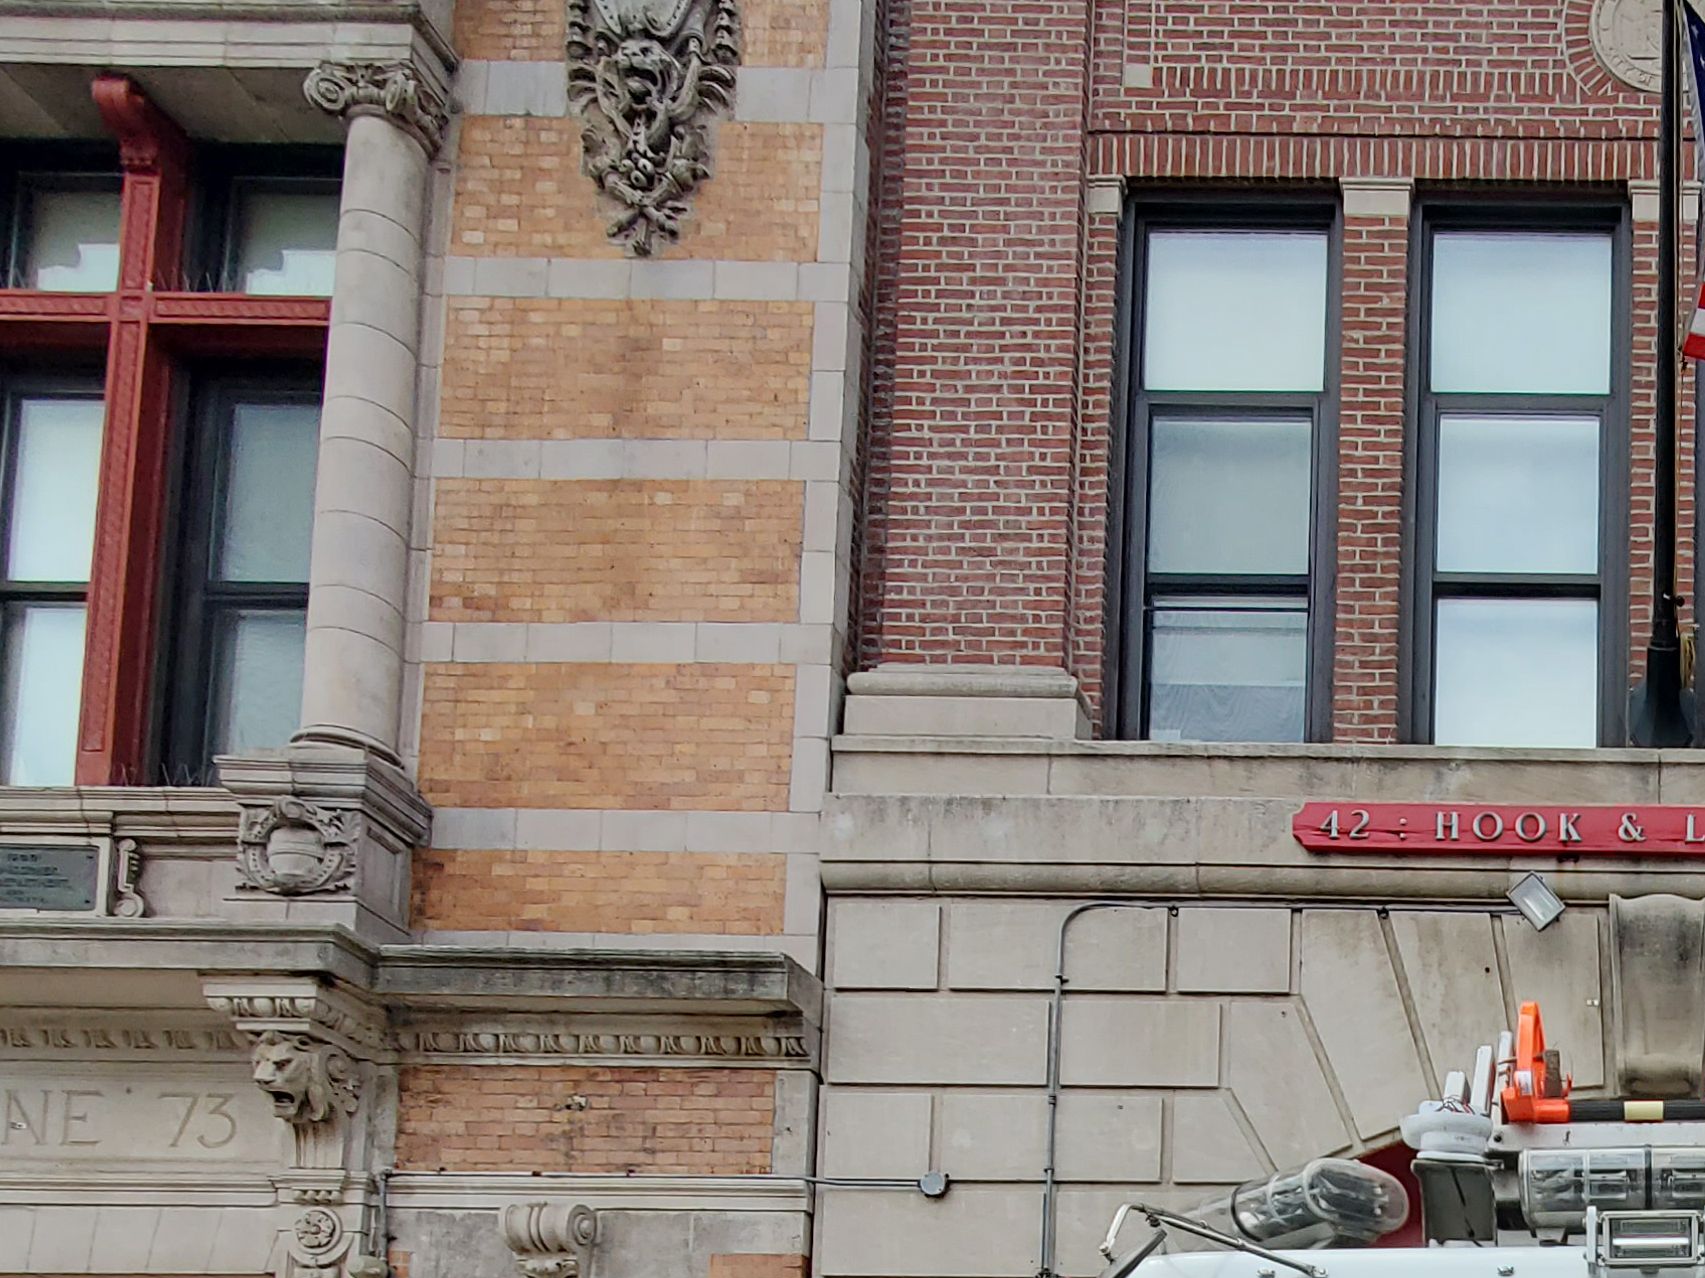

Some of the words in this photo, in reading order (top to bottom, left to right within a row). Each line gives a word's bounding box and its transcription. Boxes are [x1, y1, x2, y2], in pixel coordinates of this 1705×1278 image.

[1320, 809, 1371, 840] 42
[1434, 810, 1583, 843] HOOK
[1617, 811, 1648, 843] &
[157, 1091, 237, 1150] 73
